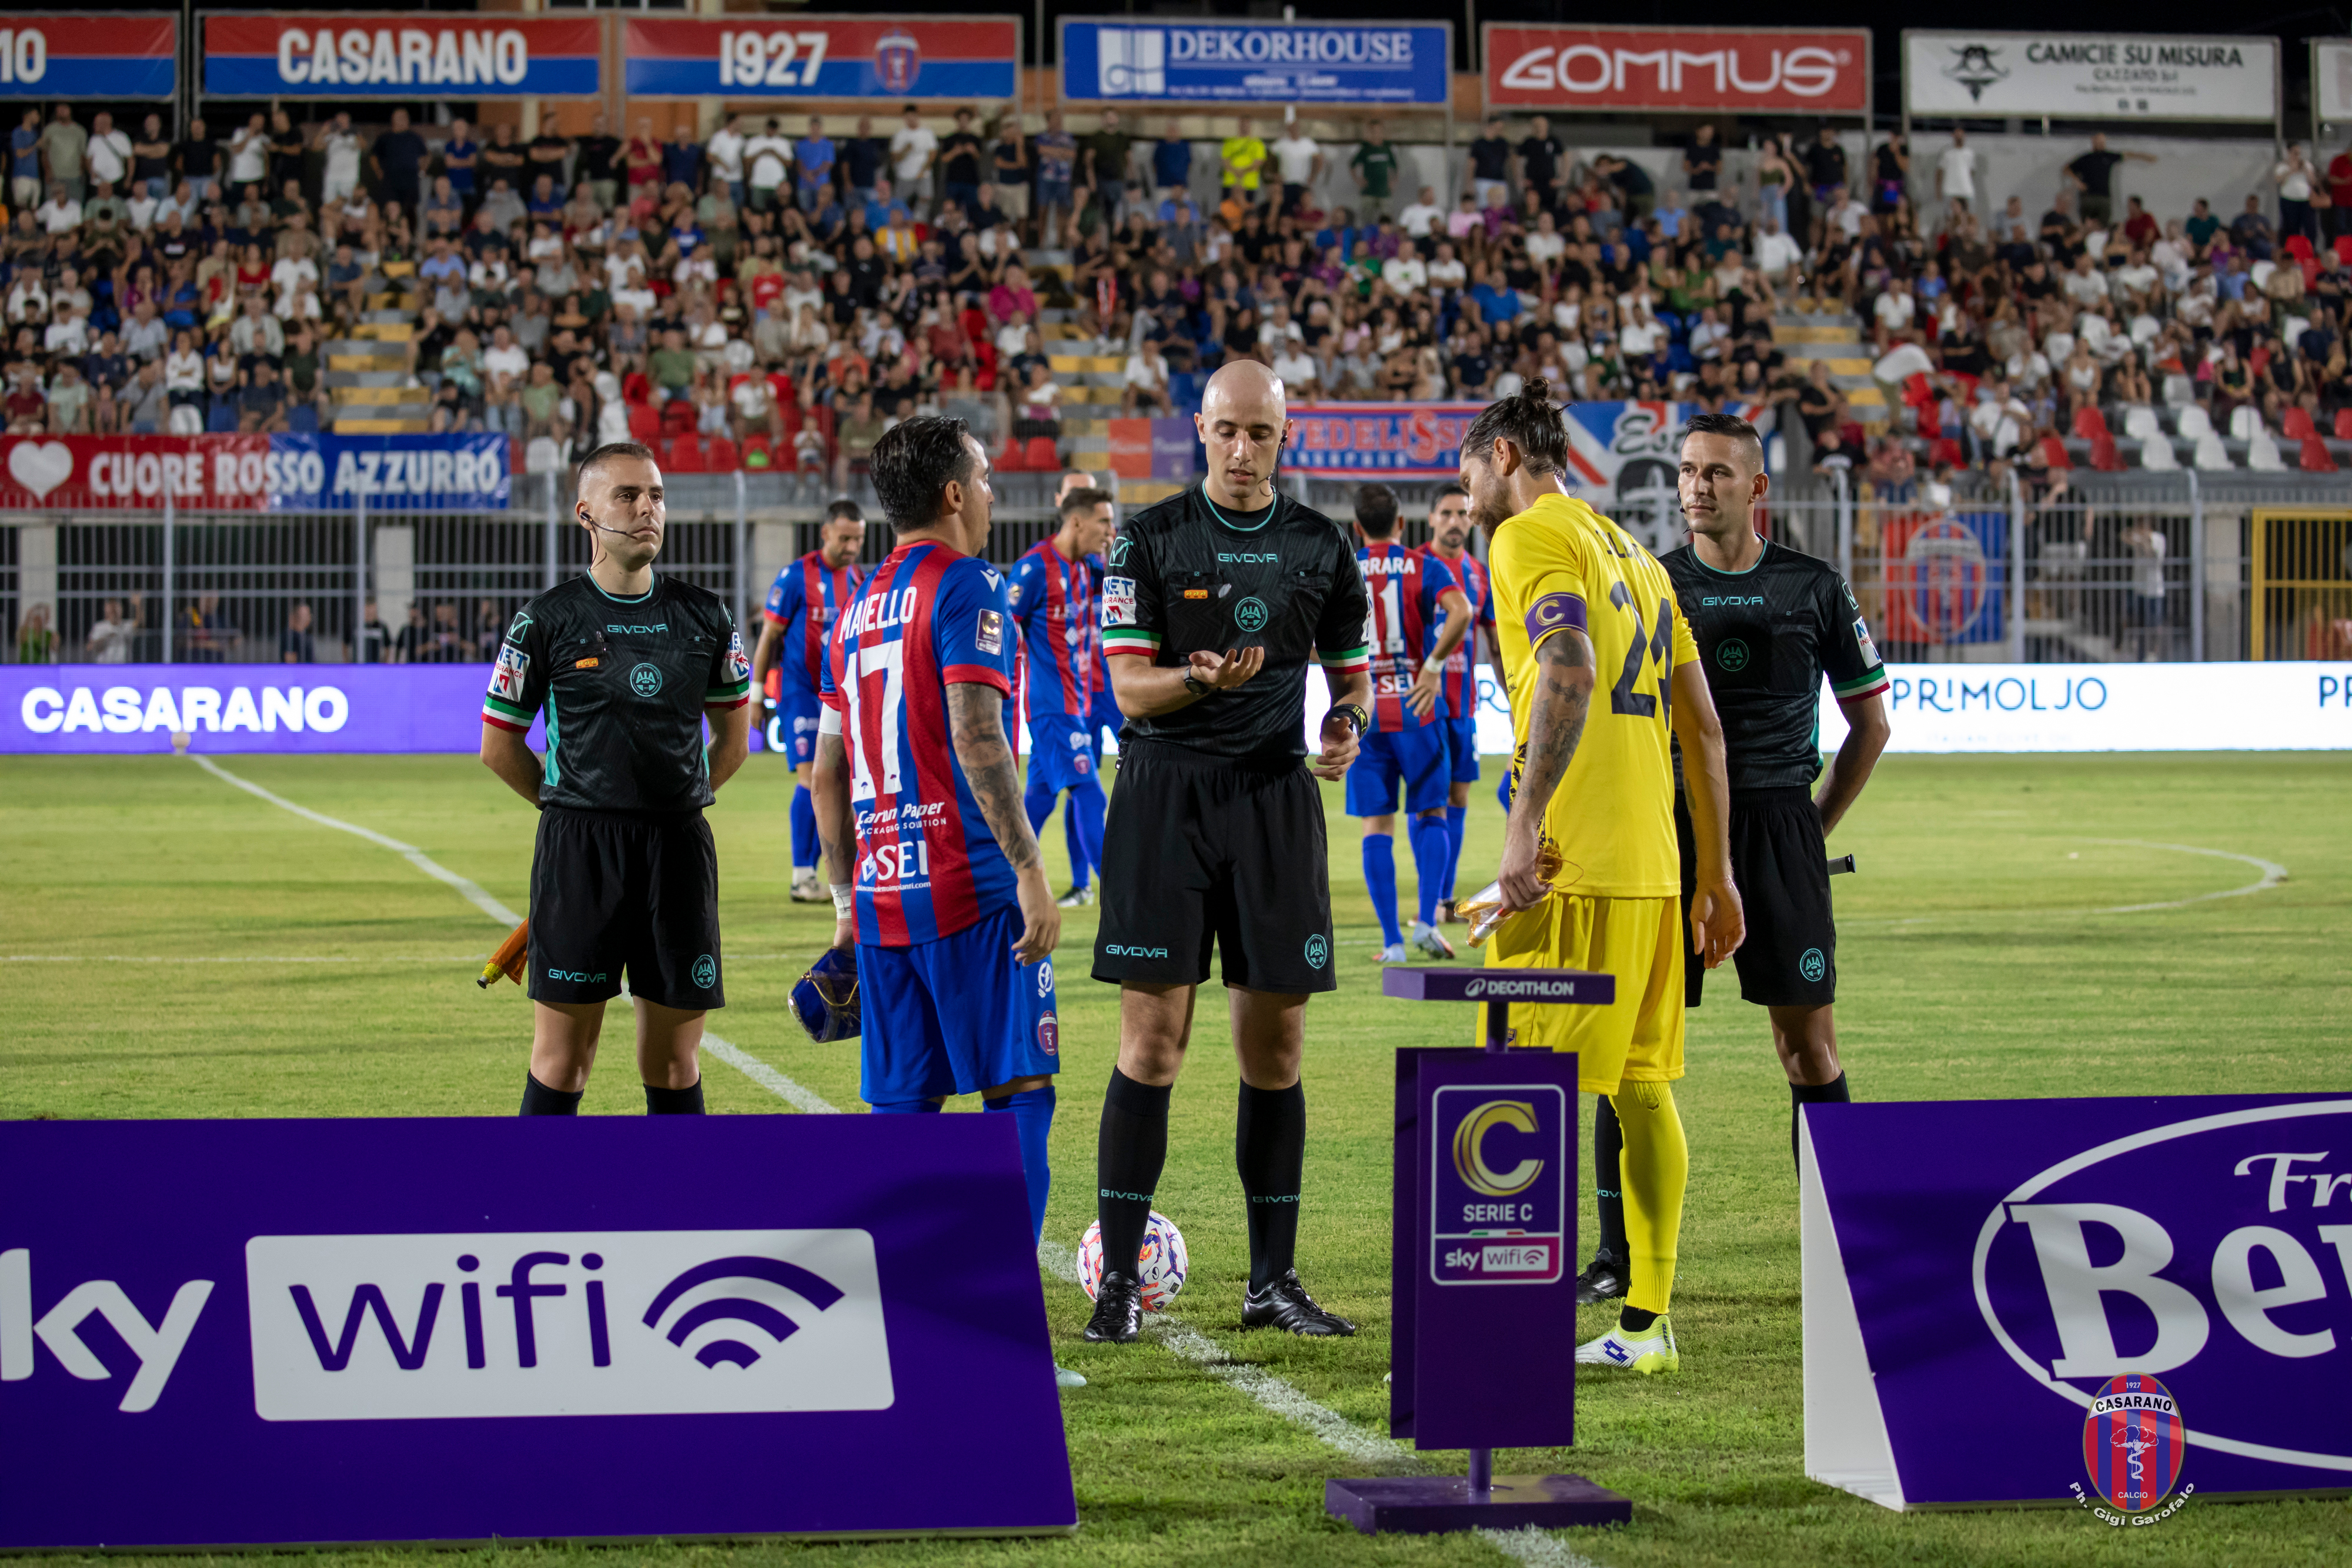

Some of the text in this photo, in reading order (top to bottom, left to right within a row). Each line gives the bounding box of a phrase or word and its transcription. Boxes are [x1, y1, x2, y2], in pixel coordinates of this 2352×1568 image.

[278, 28, 527, 84] CASARANO
[719, 30, 828, 86] 1927
[1170, 30, 1414, 61] DEKORHOUSE
[2026, 42, 2244, 68] CAMICIE SU MISURA
[89, 450, 500, 497] CUORE ROSSO AZZURRO
[1218, 553, 1278, 563] GIVOVA
[1103, 579, 1133, 596] NET
[1702, 596, 1763, 606] GIVOVA
[838, 586, 917, 643] MAIELLO
[607, 623, 669, 634] GIVOVA
[1893, 677, 2107, 712] PRIMOLJO
[21, 686, 349, 733] CASARANO
[840, 639, 904, 803] 17
[901, 801, 945, 819] Paper
[903, 817, 947, 830] SOLUTION
[876, 840, 929, 881] SEI
[1106, 944, 1168, 958] GIVOVA
[549, 968, 606, 983] GIVOVA
[1487, 981, 1574, 996] DECATHLON
[2234, 1151, 2352, 1213] Fr
[1463, 1203, 1533, 1222] SERIE C
[1445, 1248, 1521, 1271] sky wifi
[0, 1248, 612, 1413] ky wifi
